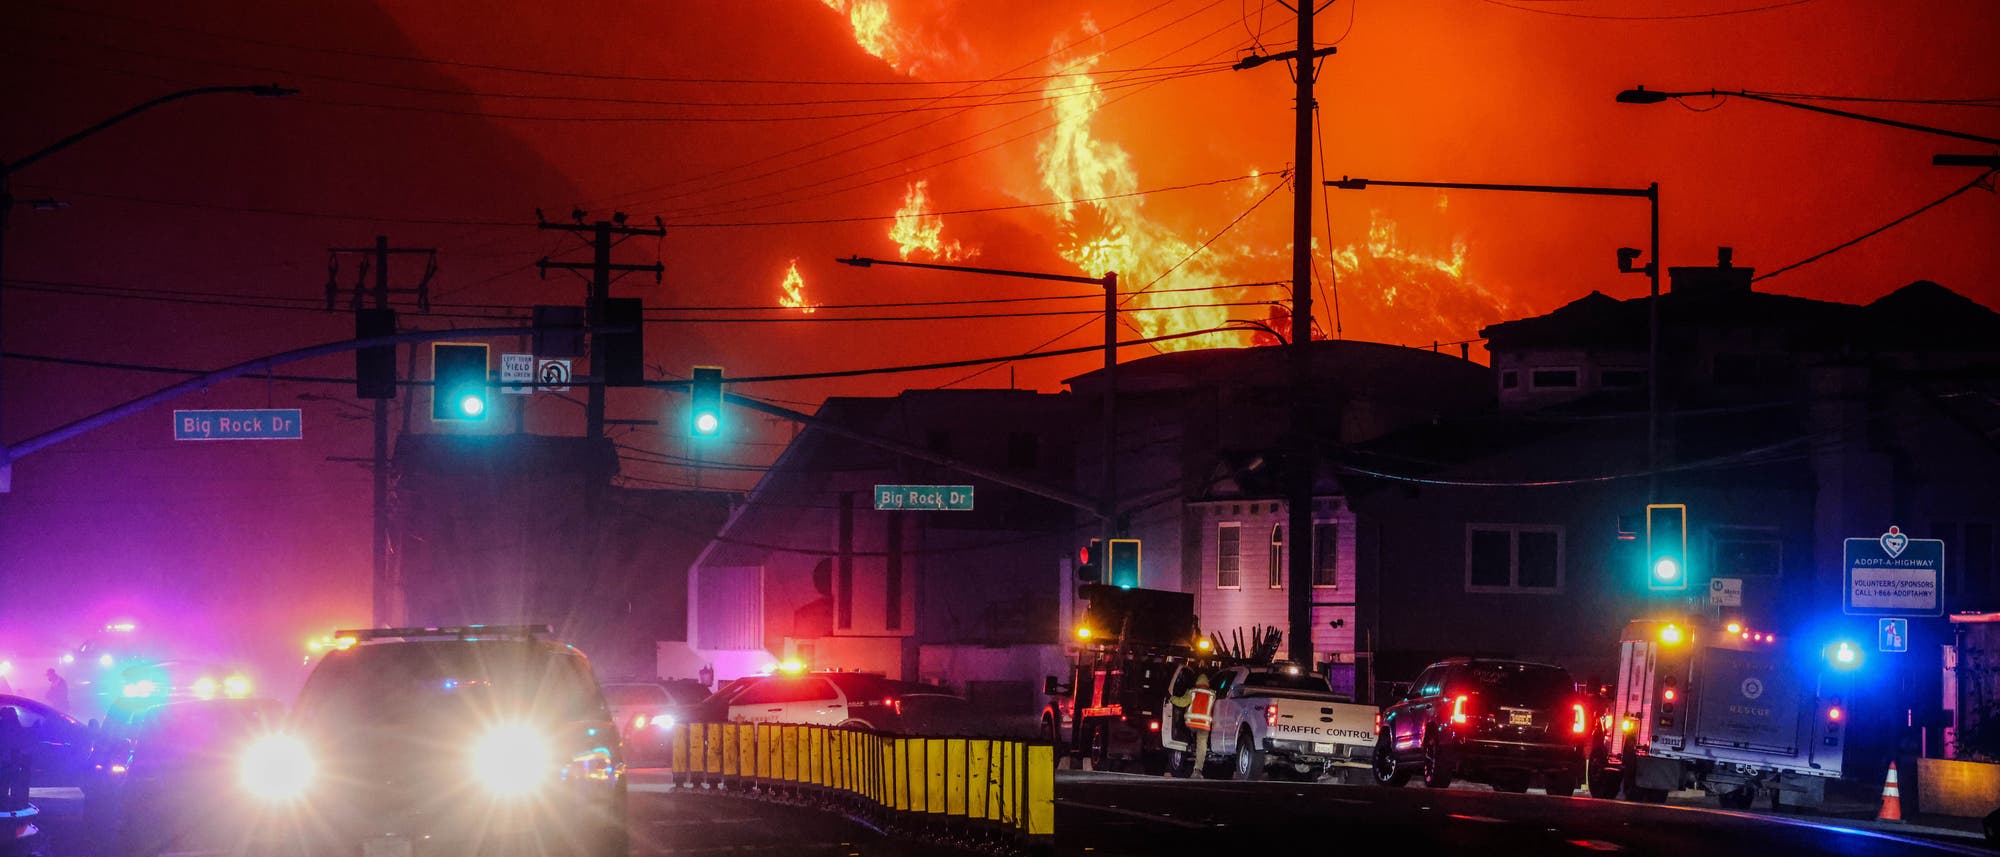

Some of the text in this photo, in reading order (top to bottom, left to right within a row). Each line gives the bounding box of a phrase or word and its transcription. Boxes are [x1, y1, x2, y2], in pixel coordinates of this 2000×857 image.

[506, 362, 530, 371] YIELD
[184, 416, 292, 438] Big Rock Dr
[881, 491, 966, 508] Big Rock Dr
[1854, 558, 1934, 567] ADOPT-A-HIGHWAY
[1854, 579, 1934, 589] VOLUNTEERS/SPONSORS
[1855, 589, 1872, 597] CALL
[1729, 704, 1769, 717] RESCUE
[1277, 724, 1374, 740] TRAFFIC CONTROL
